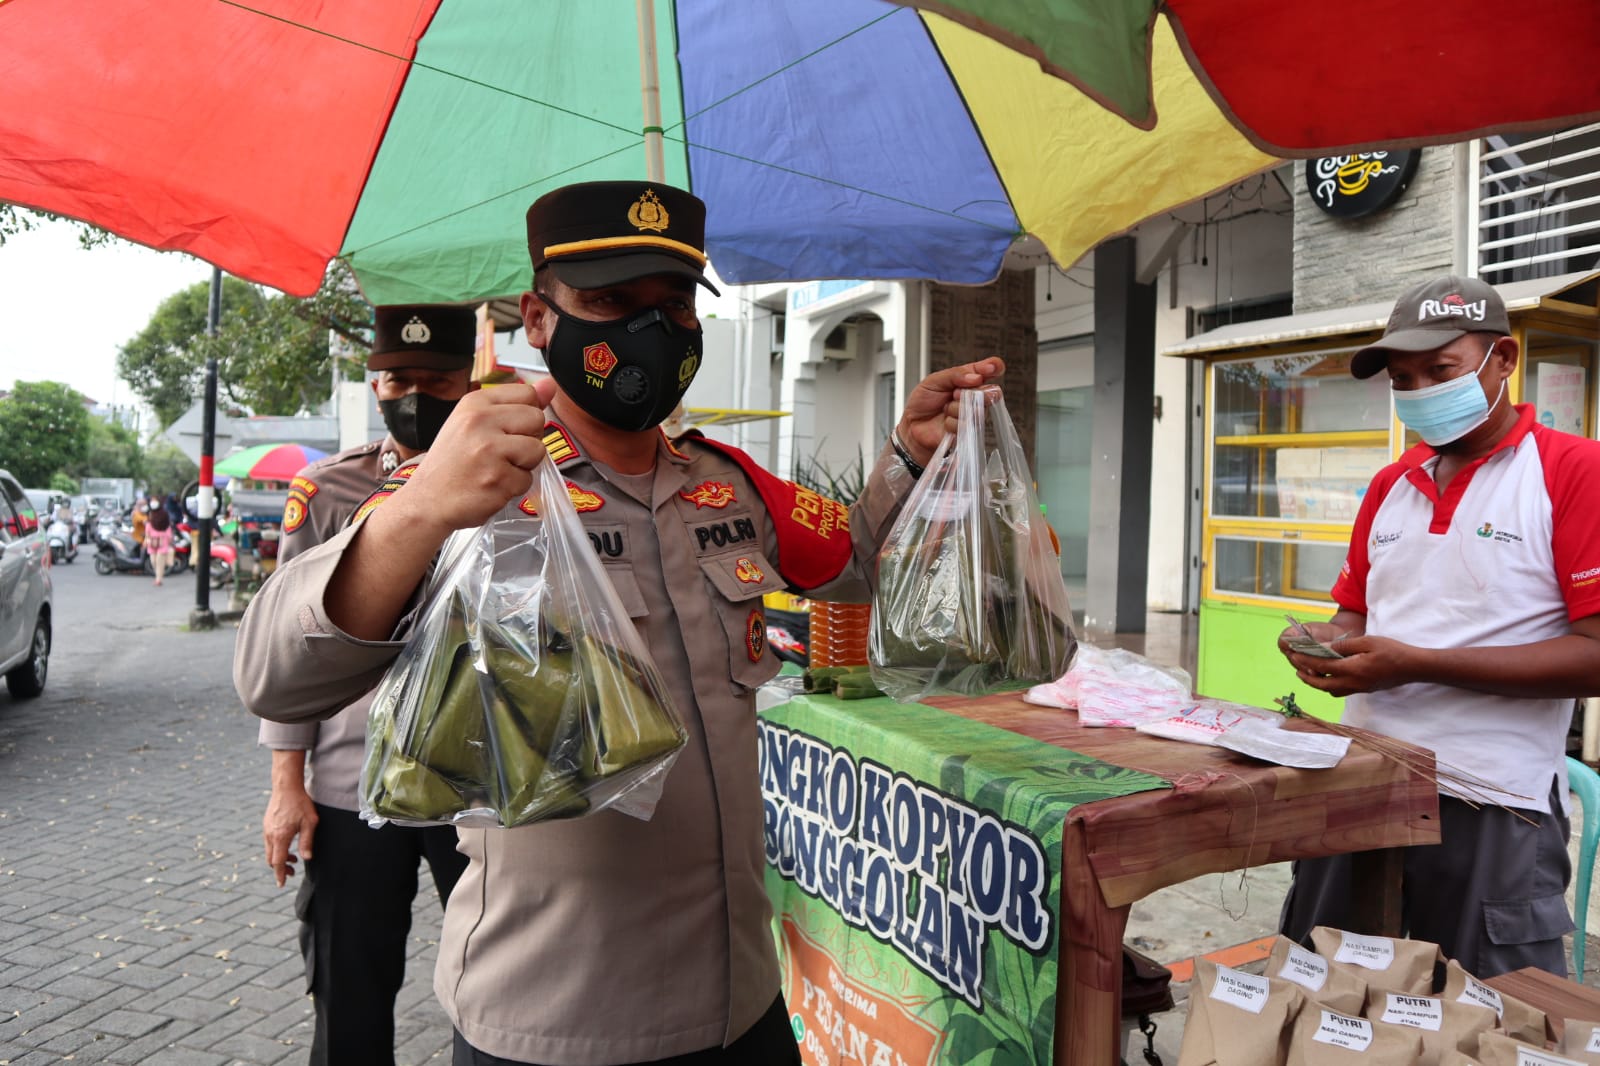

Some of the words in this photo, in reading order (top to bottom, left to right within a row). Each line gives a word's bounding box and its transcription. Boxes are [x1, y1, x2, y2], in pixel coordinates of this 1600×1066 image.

[1418, 299, 1487, 321] RUSTY
[585, 375, 604, 389] TNI
[694, 517, 757, 551] POLRI
[863, 767, 1044, 945] KOPYOR
[764, 799, 980, 999] BONGGOLAN
[1290, 956, 1303, 966] NASI
[1303, 961, 1325, 975] CAMPUR
[1220, 975, 1237, 986] NASI
[1237, 981, 1265, 996] CAMPUR
[1226, 986, 1253, 1000] DAGING
[1472, 982, 1496, 999] PUTRI
[1396, 997, 1431, 1007] PUTRI
[1330, 1014, 1362, 1029] PUTRI
[1338, 1030, 1368, 1042] CAMPUR
